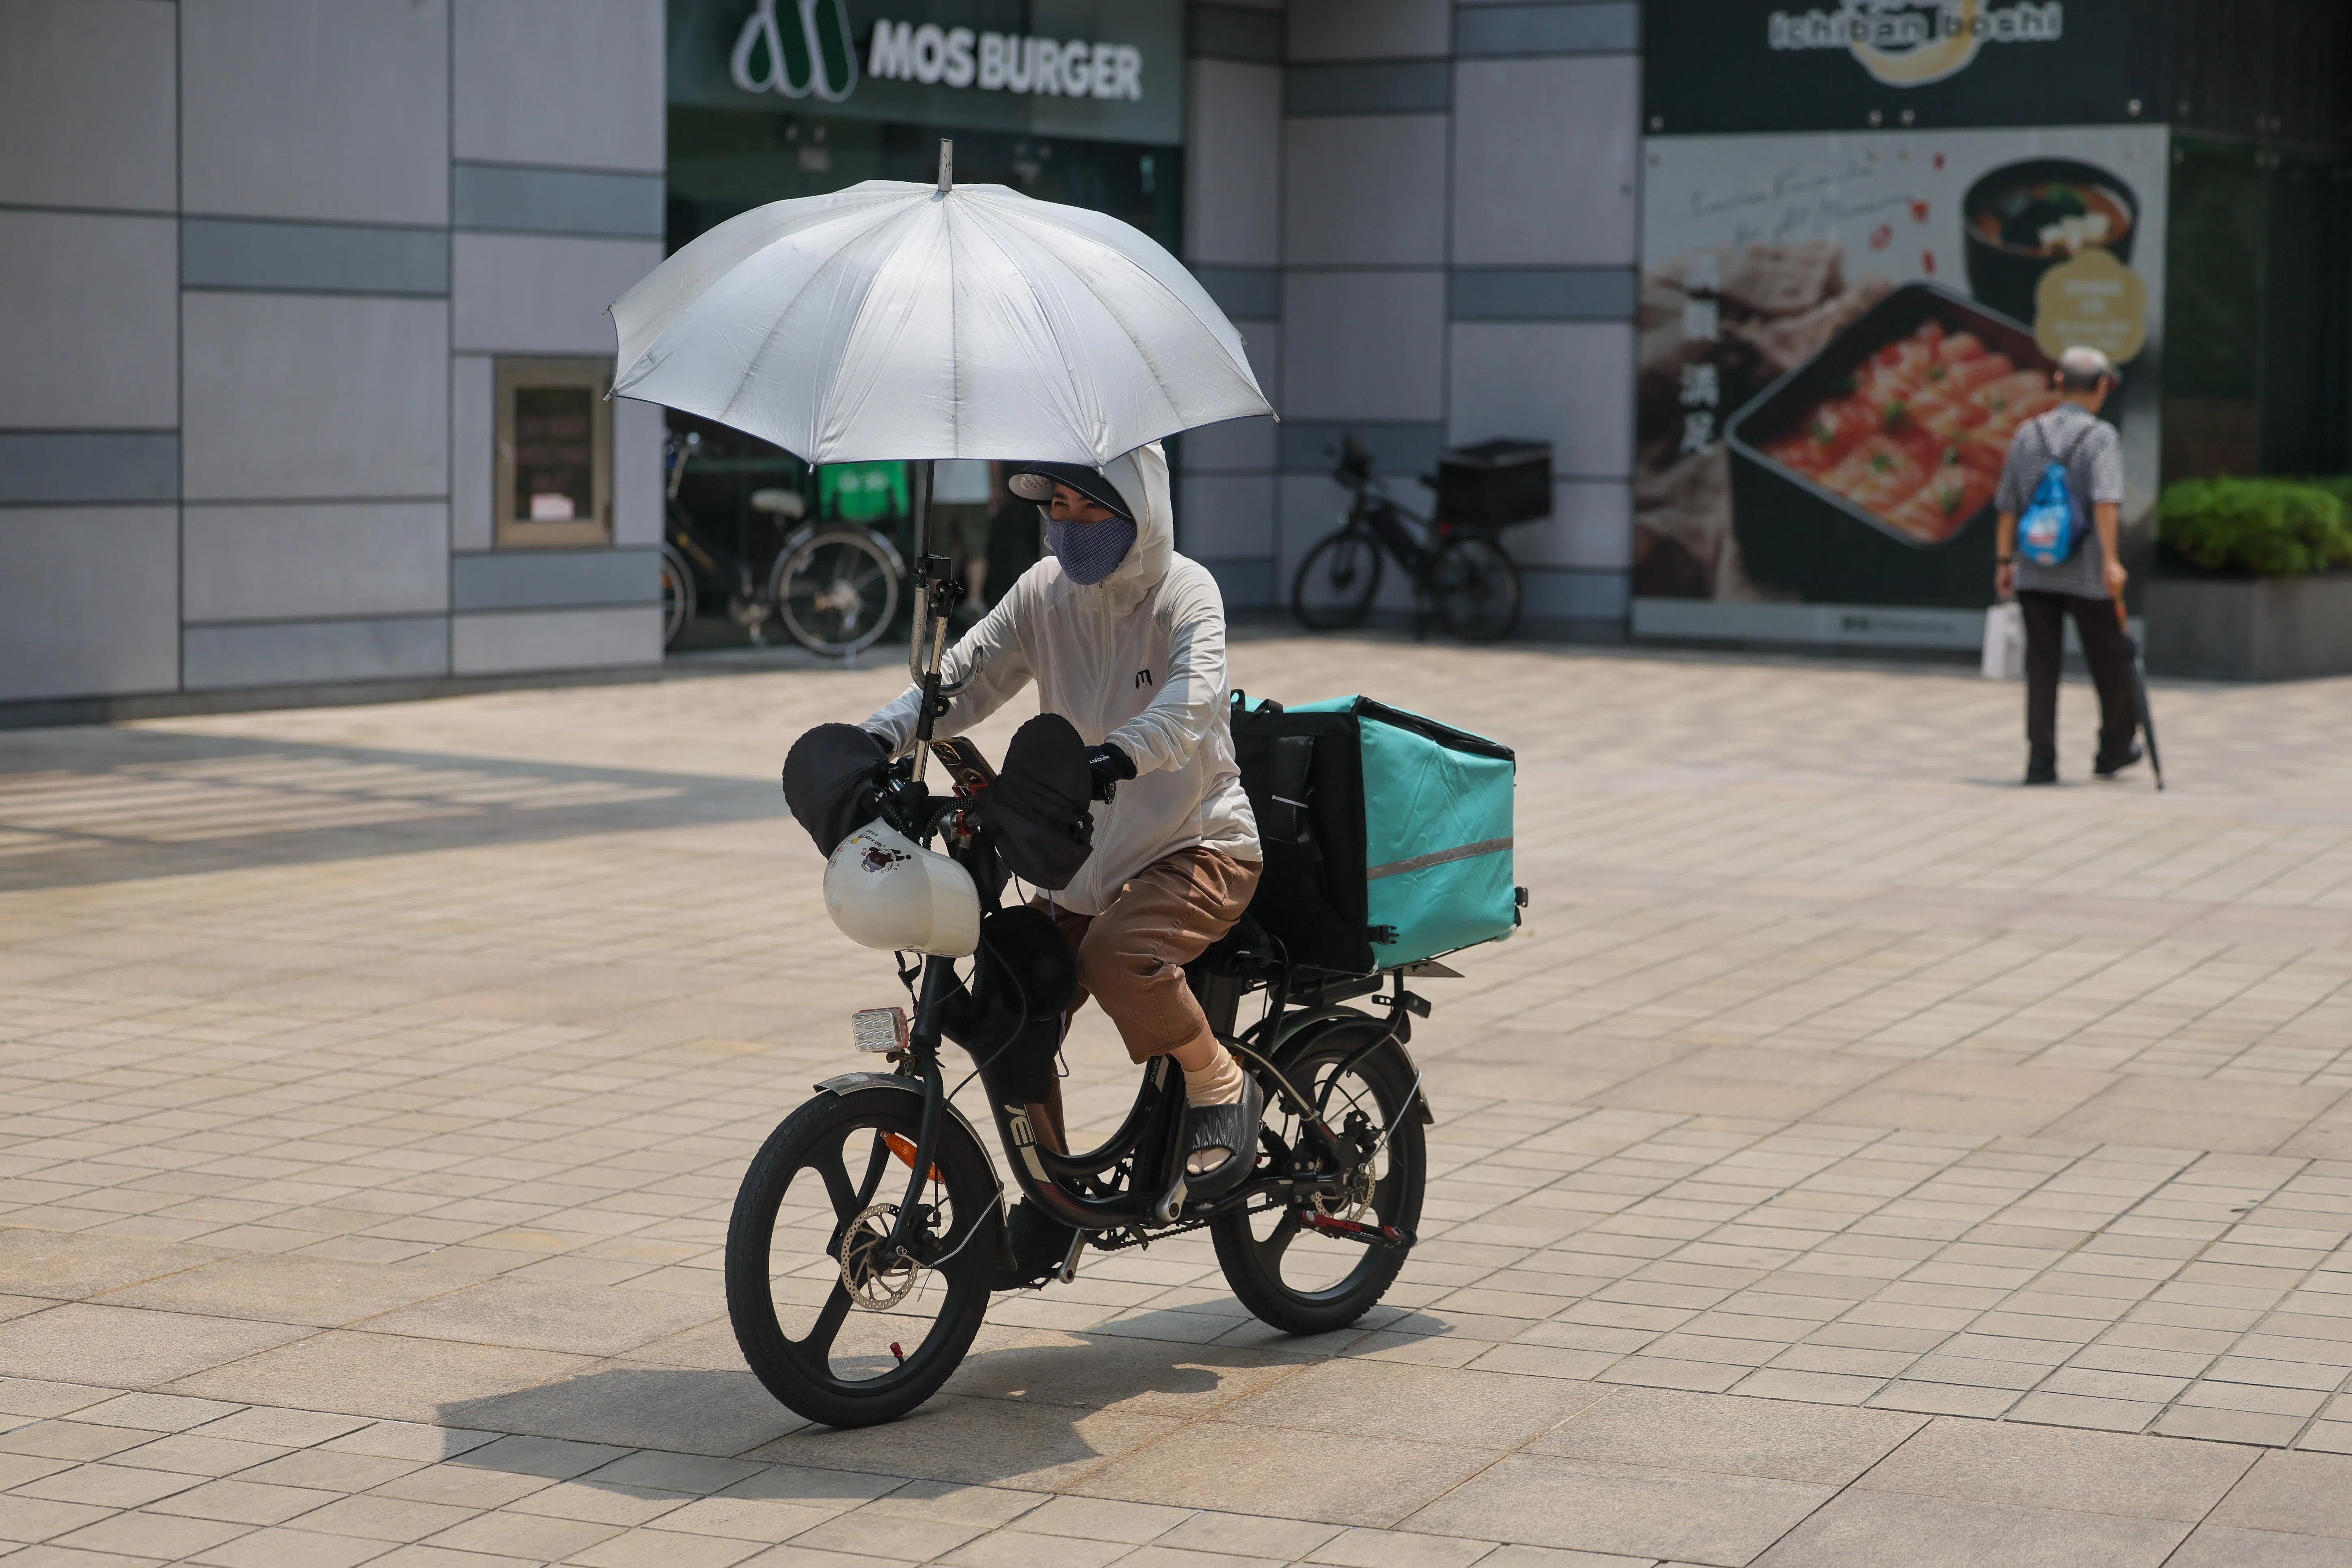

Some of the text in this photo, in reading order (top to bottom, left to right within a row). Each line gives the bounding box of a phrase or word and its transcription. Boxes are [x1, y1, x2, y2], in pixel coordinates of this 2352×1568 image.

[869, 19, 1143, 100] MOS BURGER
[1150, 1059, 1160, 1083] POWER
